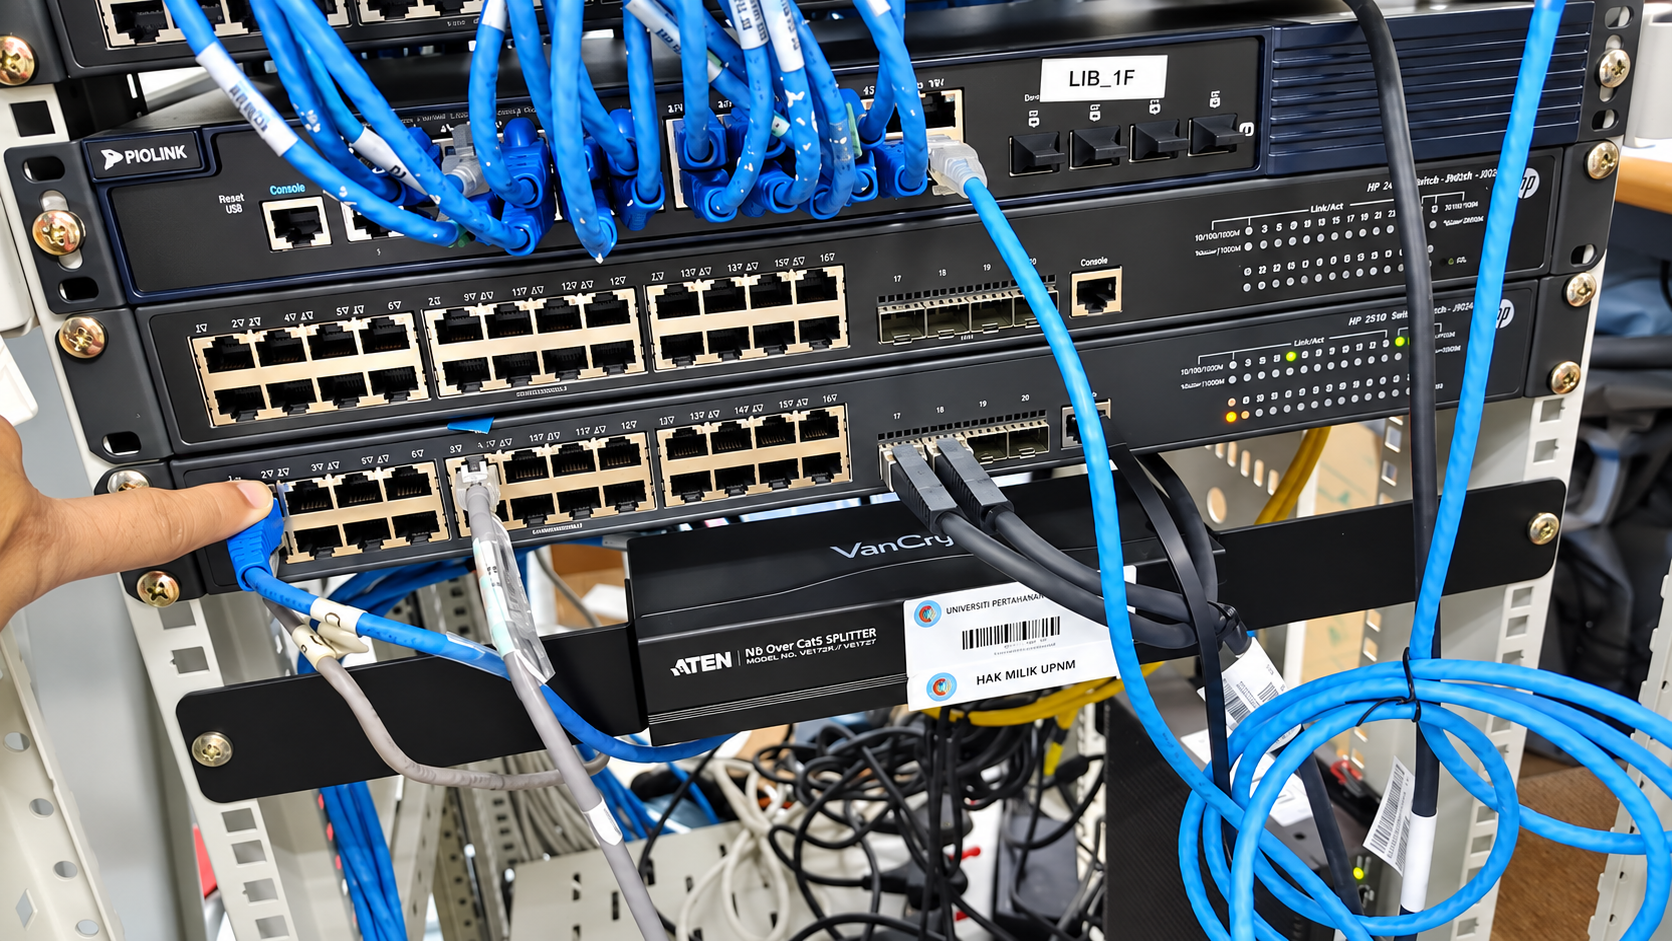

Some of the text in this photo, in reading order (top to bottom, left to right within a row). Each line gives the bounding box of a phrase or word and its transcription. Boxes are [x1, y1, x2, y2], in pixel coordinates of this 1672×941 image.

[1069, 69, 1135, 88] LIB_1F
[125, 145, 188, 164] PIOLINK
[269, 183, 306, 195] Console
[1367, 182, 1380, 192] HP
[218, 193, 245, 204] Reset
[225, 204, 243, 214] USB
[1310, 203, 1344, 213] Link/Act
[1346, 214, 1355, 223] 17
[1080, 256, 1109, 267] Console
[893, 274, 902, 283] 17
[983, 263, 992, 272] 19
[1348, 316, 1362, 326] HP
[893, 412, 901, 420] 17
[979, 400, 988, 408] 19
[1021, 394, 1030, 402] 20
[829, 533, 955, 559] VanCry
[946, 600, 990, 615] UNIVERSITI
[765, 642, 795, 654] Over
[825, 627, 877, 645] SPLITTER
[669, 651, 733, 677] ATEN
[746, 654, 780, 665] MODEL
[976, 659, 1076, 686] HAK MILIK UPNM
